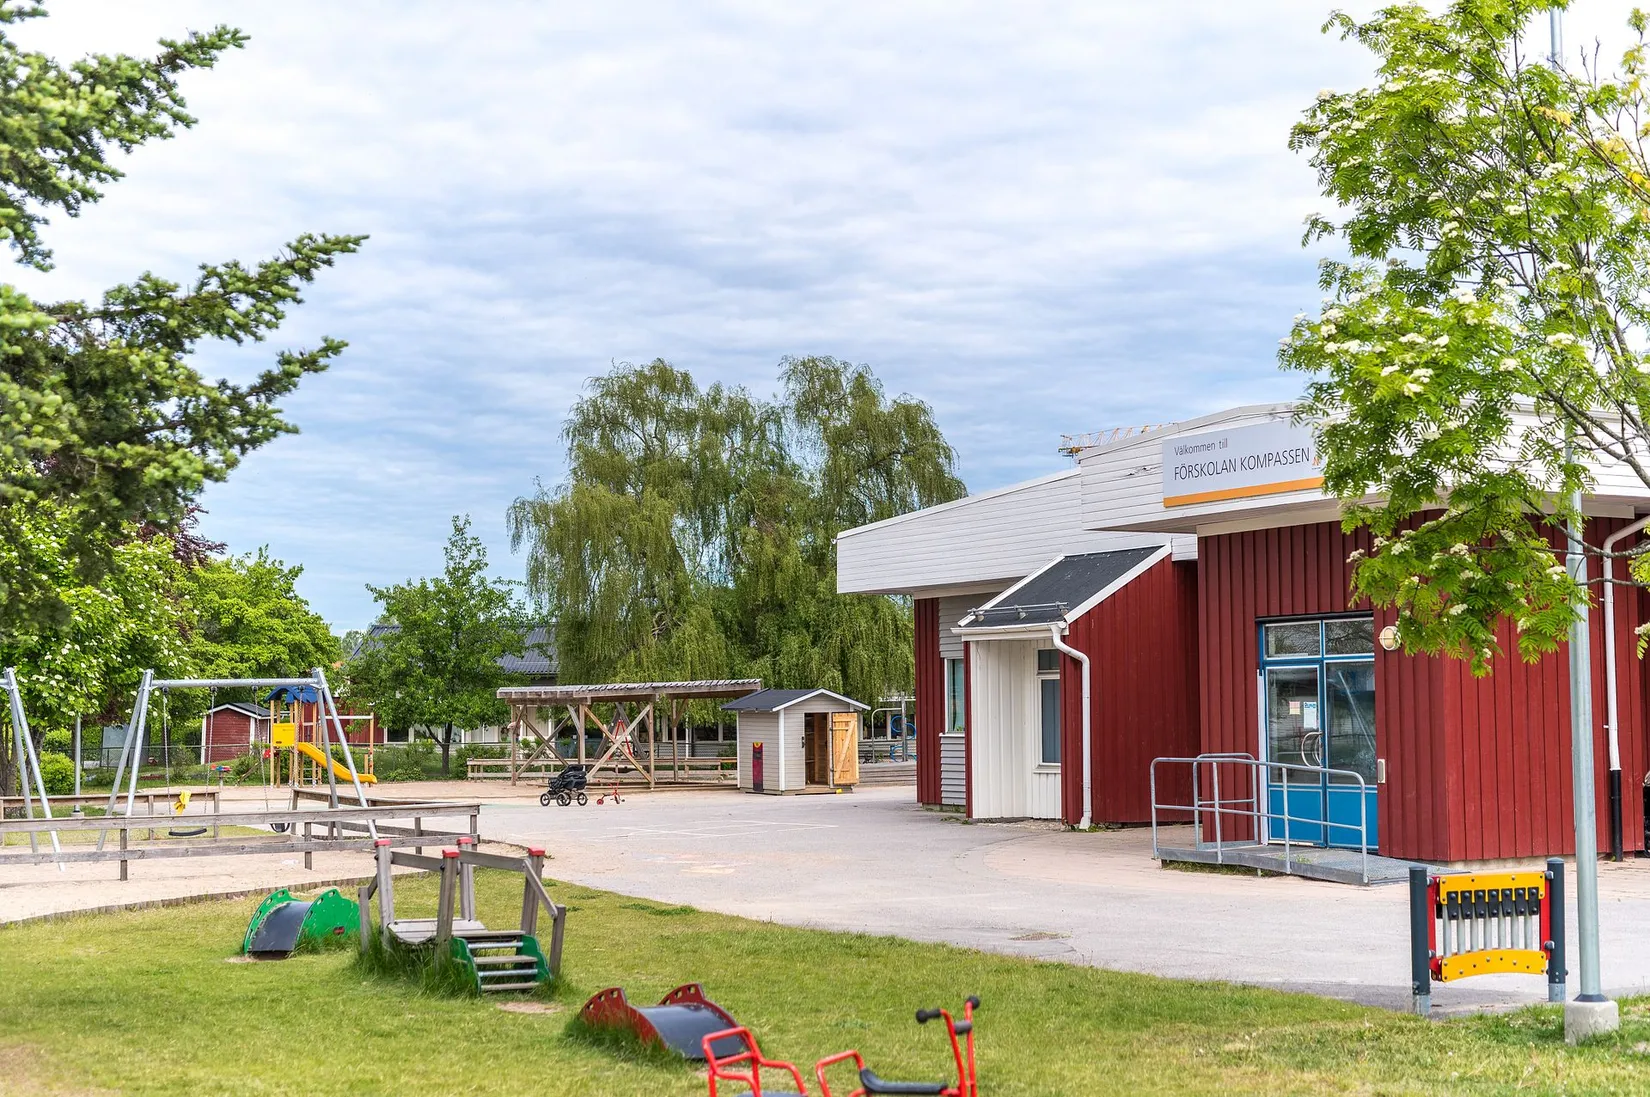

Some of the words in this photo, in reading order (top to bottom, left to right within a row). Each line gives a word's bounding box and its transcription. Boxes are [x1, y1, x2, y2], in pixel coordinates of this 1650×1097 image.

[1174, 442, 1216, 456] Välkommen
[1219, 438, 1228, 449] till
[1174, 458, 1237, 480] FÖRSKOLAN
[1240, 447, 1310, 471] KOMPASSEN
